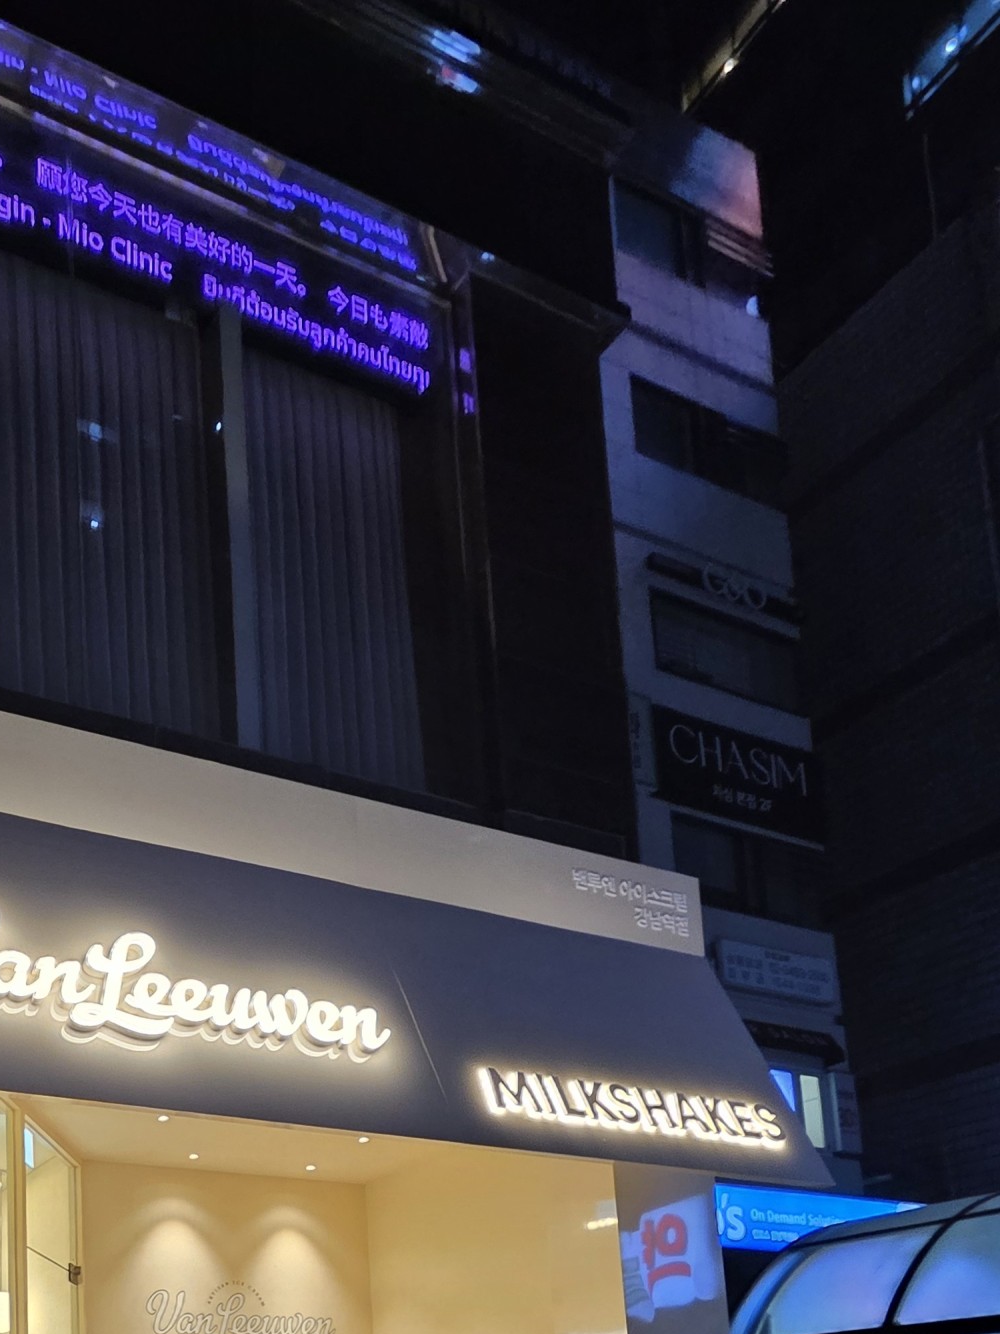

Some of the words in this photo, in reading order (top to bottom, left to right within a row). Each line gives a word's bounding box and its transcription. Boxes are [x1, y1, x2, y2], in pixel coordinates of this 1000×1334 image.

[58, 213, 103, 250] Mio
[111, 236, 173, 282] Clinic
[669, 724, 808, 797] CHASIM
[619, 879, 688, 913] 아이스크림
[634, 907, 689, 937] 강남역점
[69, 931, 391, 1050] Leeuwen
[482, 1067, 787, 1147] MILKSHAKES
[750, 1209, 765, 1222] On
[767, 1210, 807, 1225] Demand
